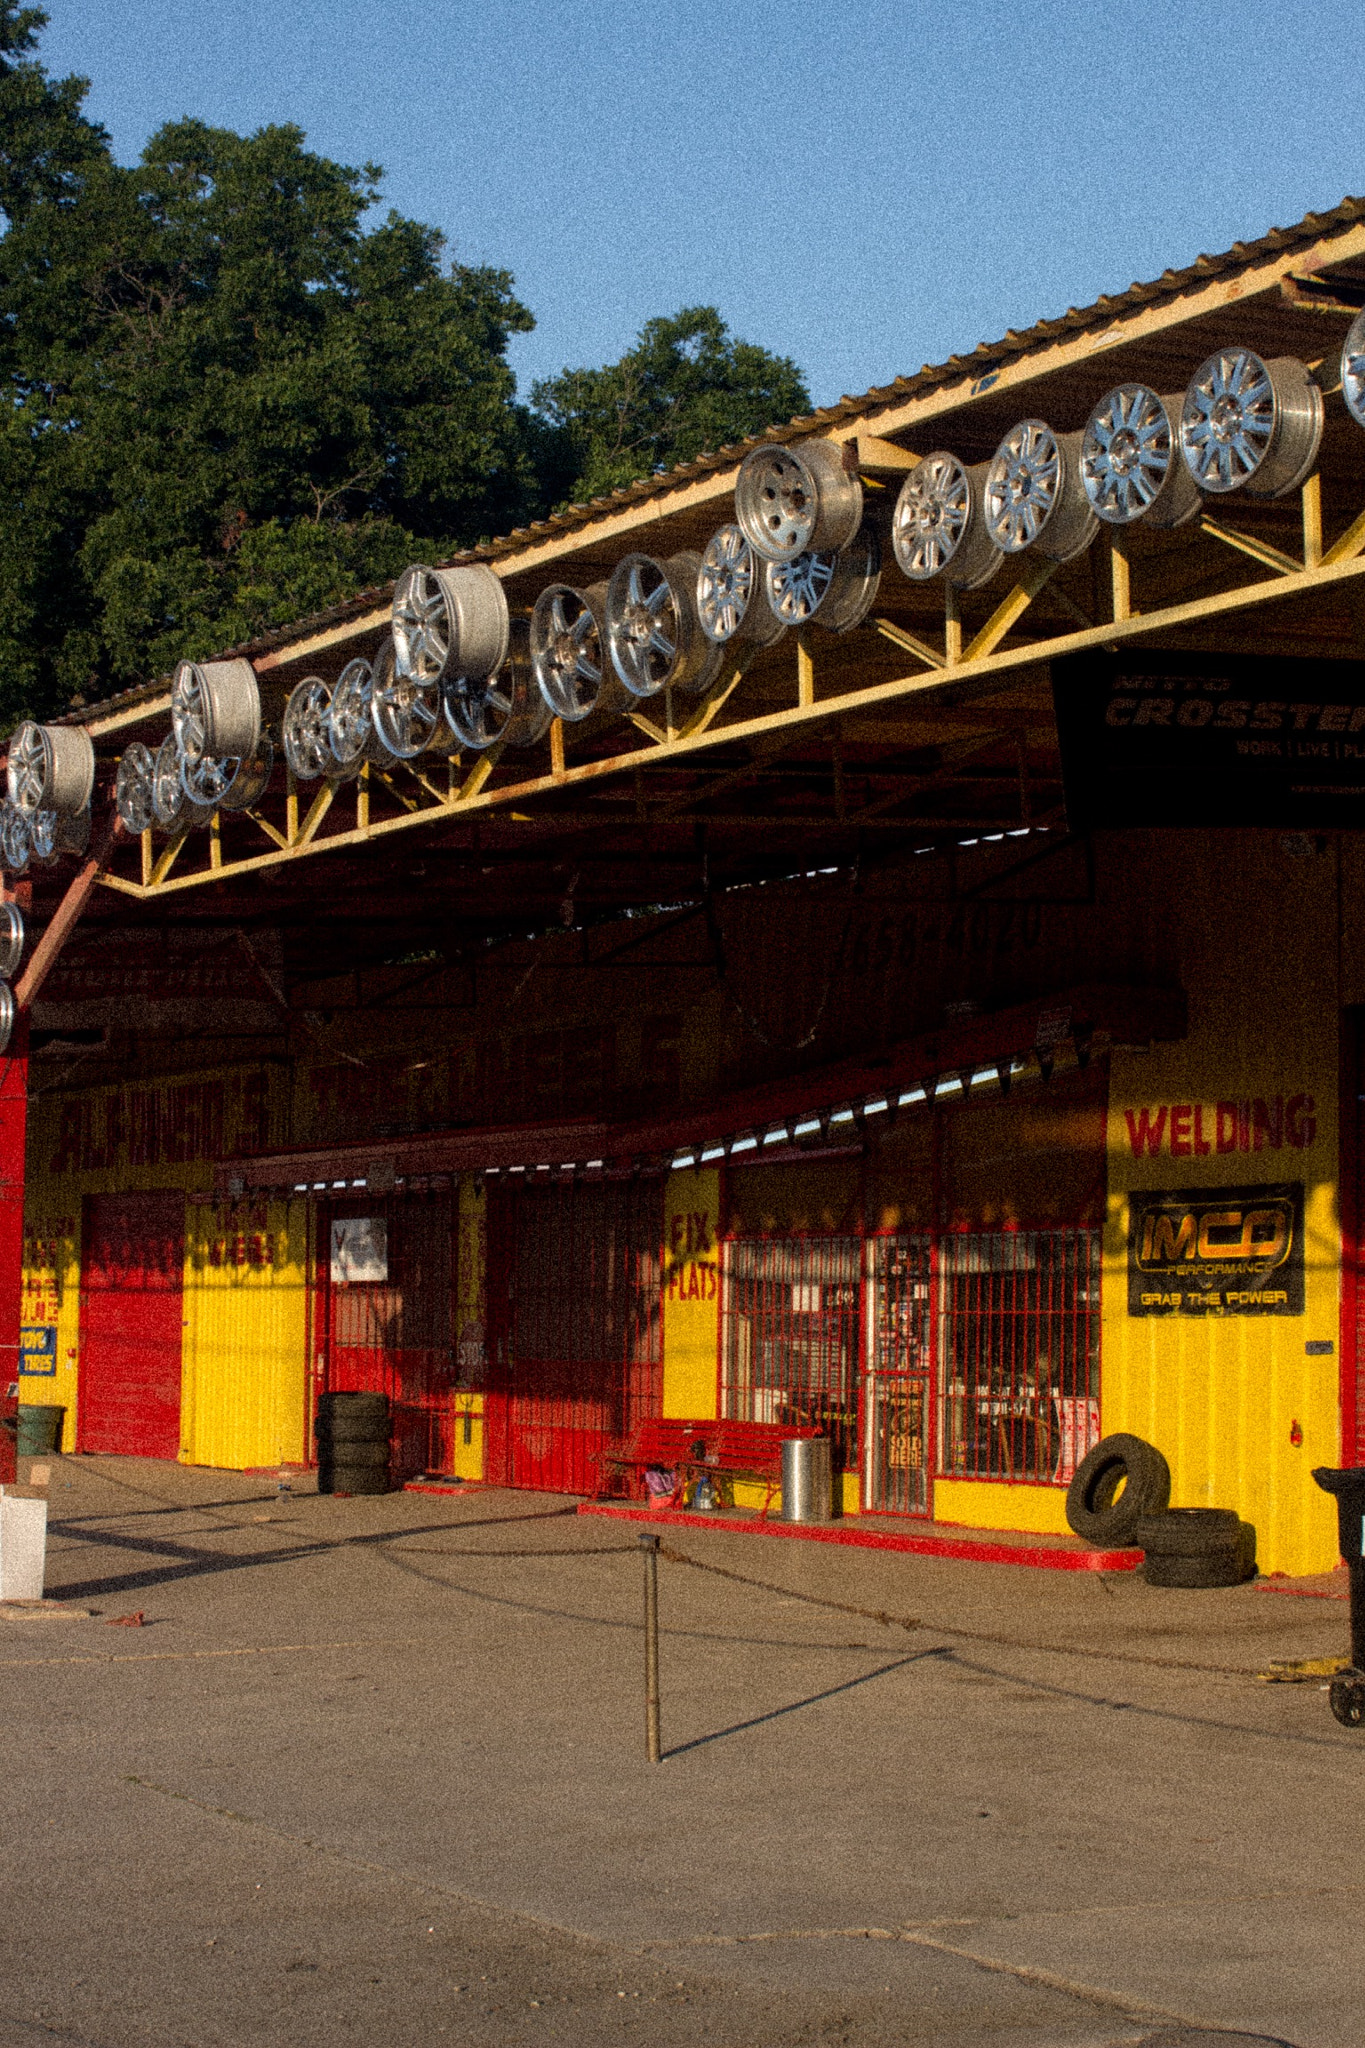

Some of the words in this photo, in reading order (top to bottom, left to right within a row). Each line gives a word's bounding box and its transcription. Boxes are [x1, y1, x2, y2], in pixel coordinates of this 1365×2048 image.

[1111, 673, 1235, 692] NITTO
[1235, 739, 1282, 757] WORK
[1297, 742, 1330, 758] LIVE
[1343, 743, 1365, 760] PL
[451, 1013, 681, 1122] WHEELS
[1124, 1093, 1317, 1158] WELDING
[670, 1212, 710, 1255] FIX
[1140, 1209, 1286, 1261] IMCO
[669, 1262, 719, 1301] FLATS
[1167, 1261, 1274, 1276] PERFORMANCE
[1141, 1292, 1182, 1306] GRAB
[1188, 1292, 1222, 1305] THE
[1226, 1290, 1288, 1304] POWER
